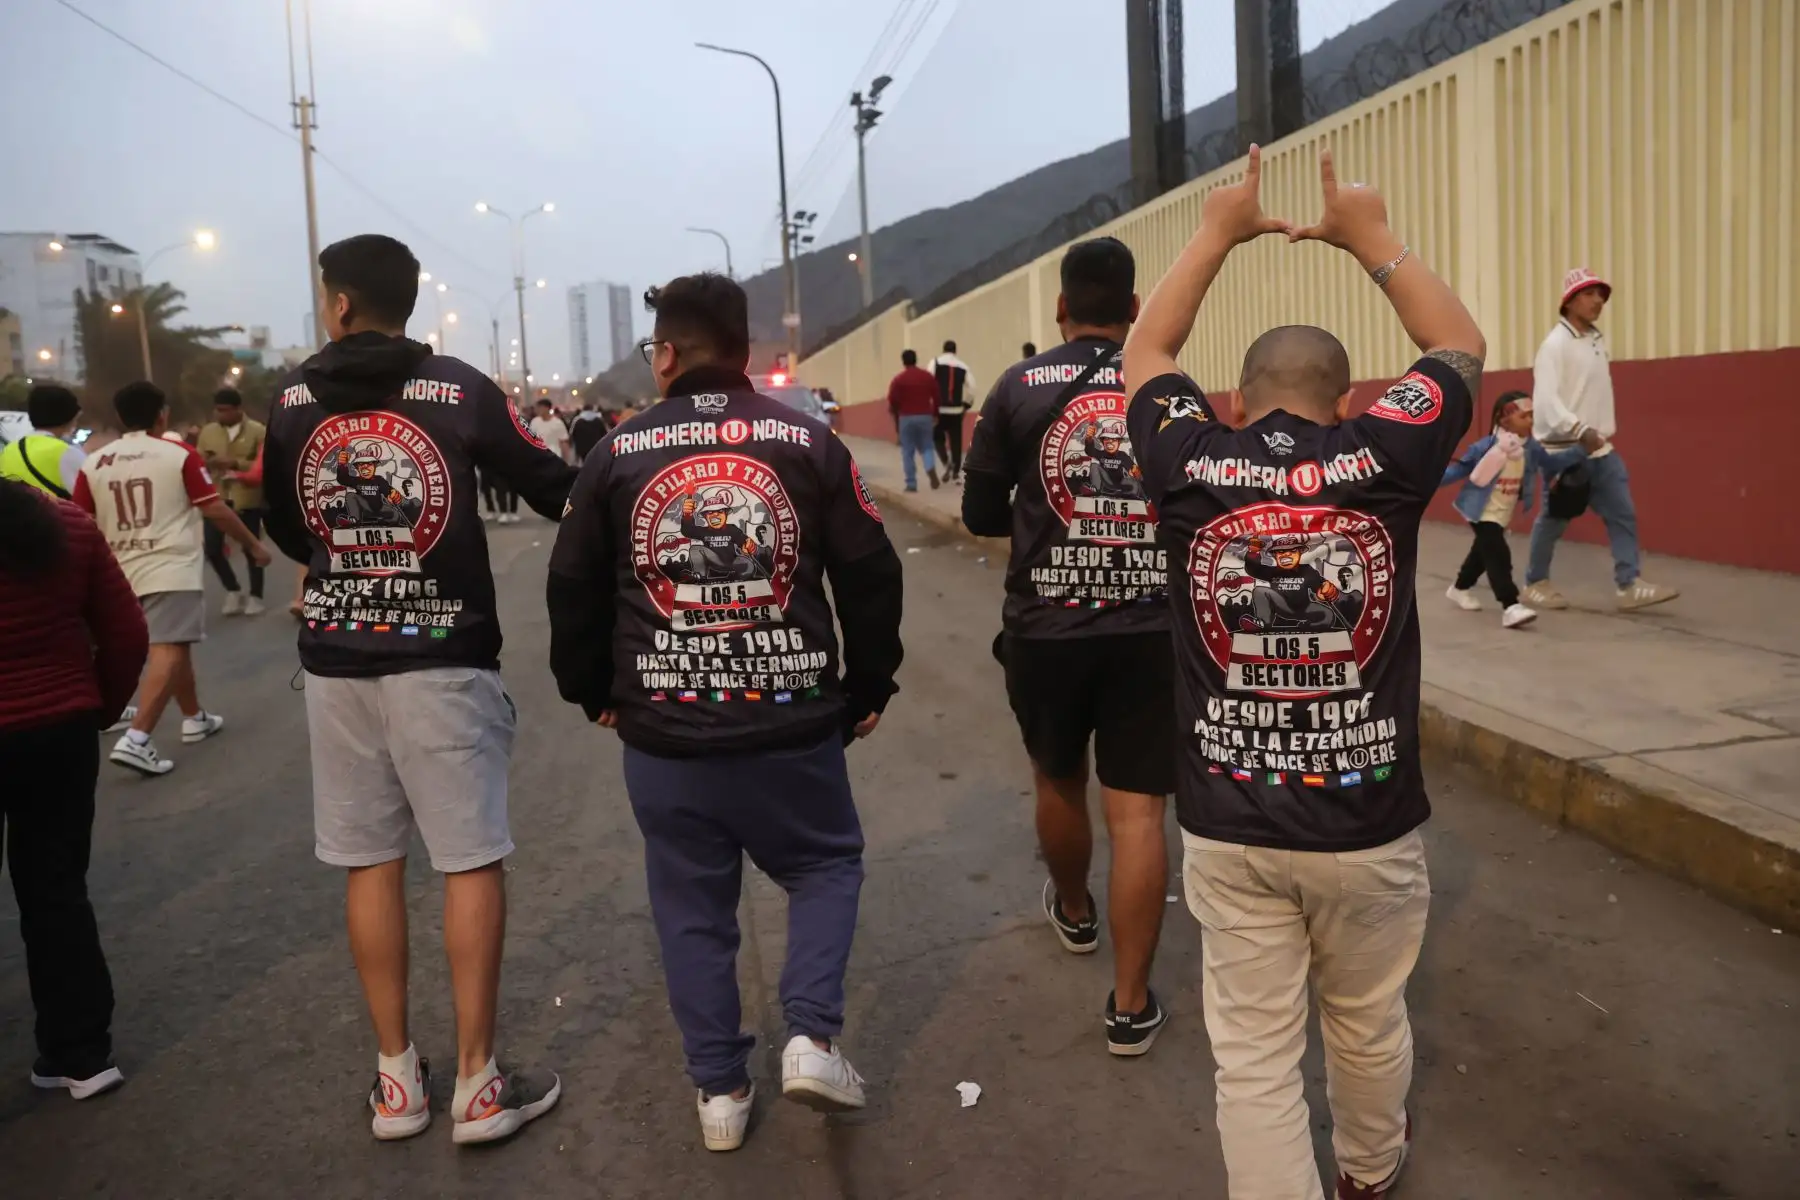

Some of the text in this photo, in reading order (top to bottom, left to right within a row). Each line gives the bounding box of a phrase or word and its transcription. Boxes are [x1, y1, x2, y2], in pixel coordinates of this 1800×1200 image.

[1025, 364, 1117, 387] TRINCHRA
[403, 378, 461, 405] NORTE
[613, 422, 717, 457] TRINCHERA
[753, 419, 811, 447] NORTE
[1045, 422, 1069, 479] BARRIO
[1066, 398, 1116, 423] PILERO
[302, 449, 320, 510] BARRIO
[315, 417, 370, 450] PILERO
[377, 418, 388, 432] Y
[108, 477, 153, 531] 10
[636, 498, 659, 567] BARRIO
[654, 462, 719, 499] PILERO
[726, 462, 737, 476] Y
[1095, 499, 1129, 518] LOS 5
[1079, 519, 1146, 539] SECTORES
[1301, 514, 1314, 530] Y
[356, 530, 394, 547] LOS 5
[341, 550, 411, 569] SECTORES
[1050, 546, 1114, 568] DESDE
[1030, 568, 1168, 585] HASTA LA ETERN
[384, 577, 437, 599] 1996
[701, 585, 747, 606] LOS 5
[1075, 586, 1088, 598] SE
[1091, 586, 1121, 600] NACE
[1124, 587, 1139, 600] SE
[350, 608, 383, 623] NACE
[385, 610, 402, 623] SE
[683, 605, 772, 627] SECTORES
[654, 627, 804, 655] DESDE 1996
[1262, 637, 1320, 660] LOS 5
[636, 653, 692, 671] HASTA
[699, 656, 725, 671] LA
[643, 673, 686, 689] DONDE
[688, 673, 706, 689] SE
[710, 673, 747, 689] NACE
[751, 674, 768, 689] SE
[1241, 662, 1347, 688] SECTORES
[1207, 695, 1294, 729] DESDE
[1253, 730, 1282, 751] LA
[1242, 750, 1261, 769] SE
[1265, 752, 1308, 773] NACE
[1312, 753, 1332, 773] SE
[1115, 1015, 1131, 1023] NIKE
